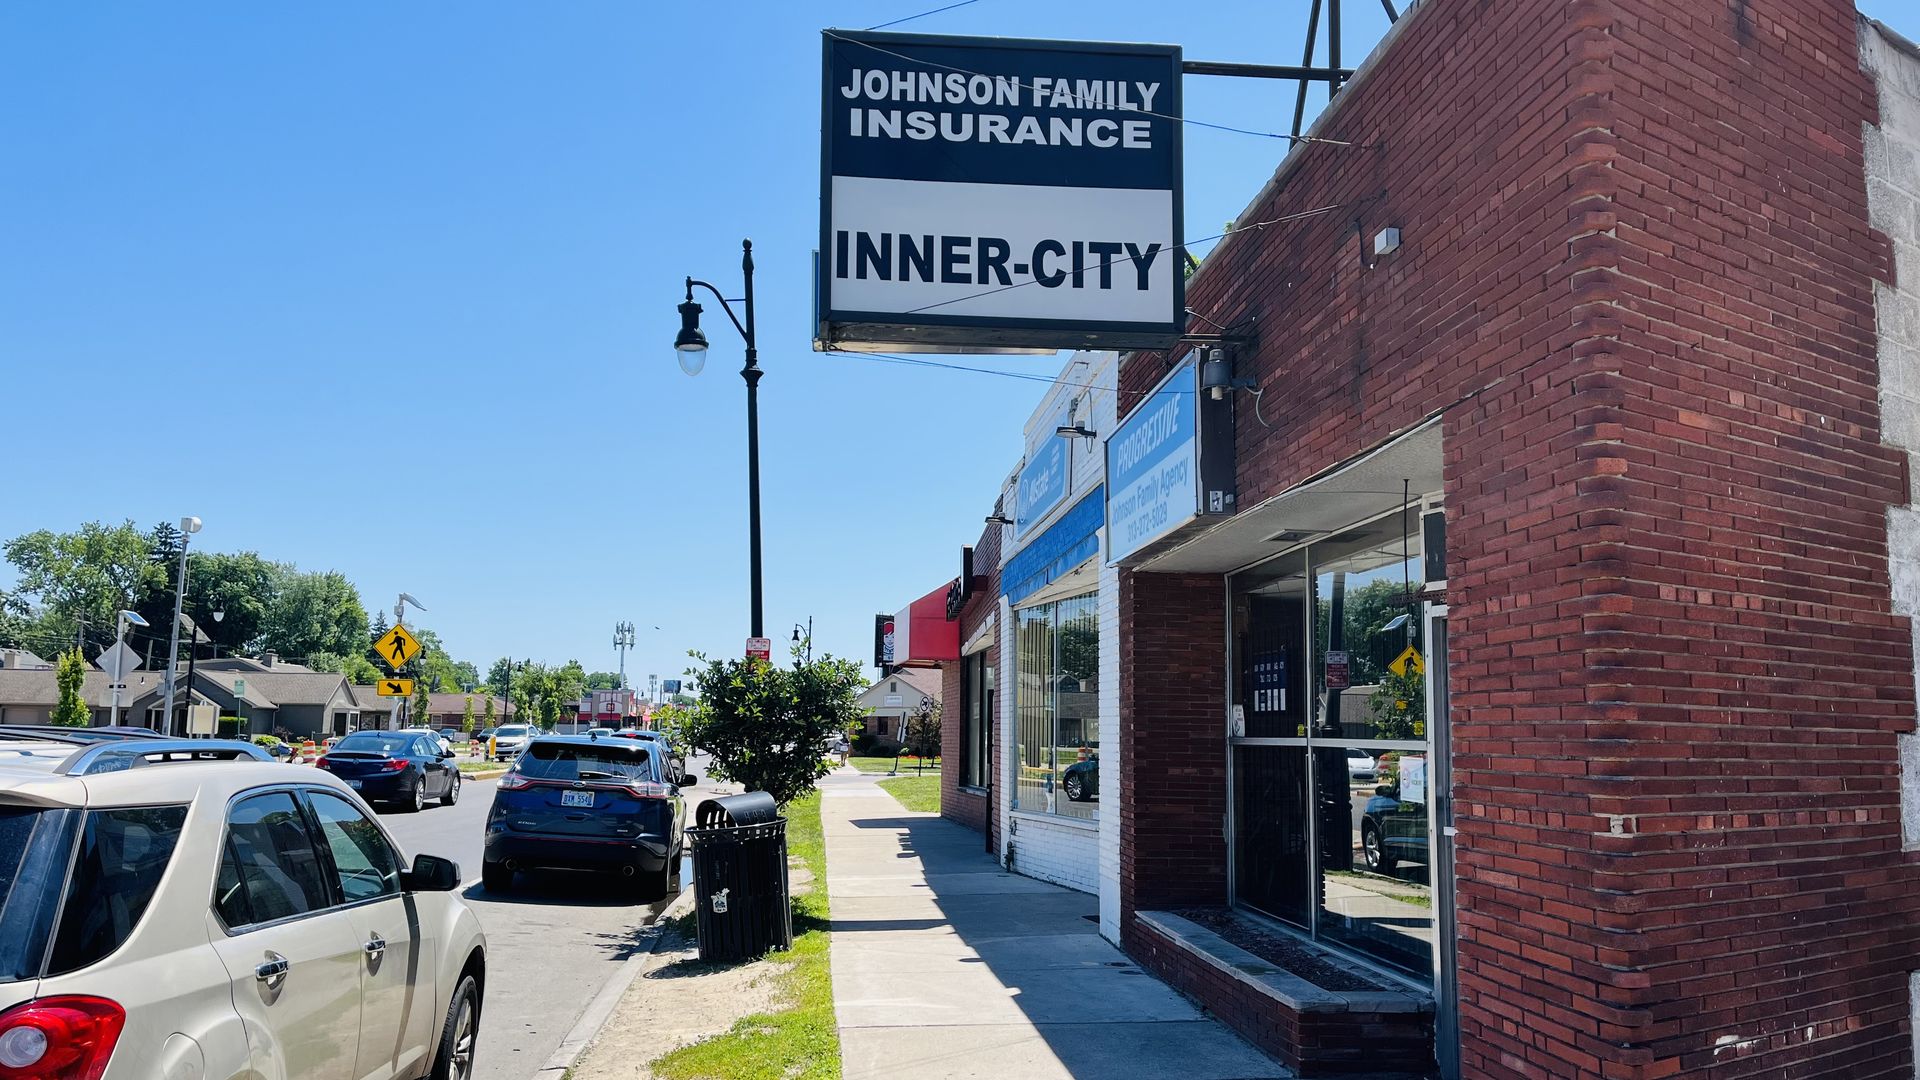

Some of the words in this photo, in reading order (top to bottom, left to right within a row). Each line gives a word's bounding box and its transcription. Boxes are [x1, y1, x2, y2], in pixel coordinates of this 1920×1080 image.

[841, 68, 1019, 107] JOHNSON
[1032, 77, 1161, 112] FAMILY
[850, 108, 1152, 149] INSURANCE
[836, 230, 1162, 291] INNER-CITY
[1116, 391, 1181, 479] PROGRESSIVE
[1112, 491, 1138, 527] Johnson
[1137, 475, 1159, 509] Family
[1160, 456, 1189, 498] Agency
